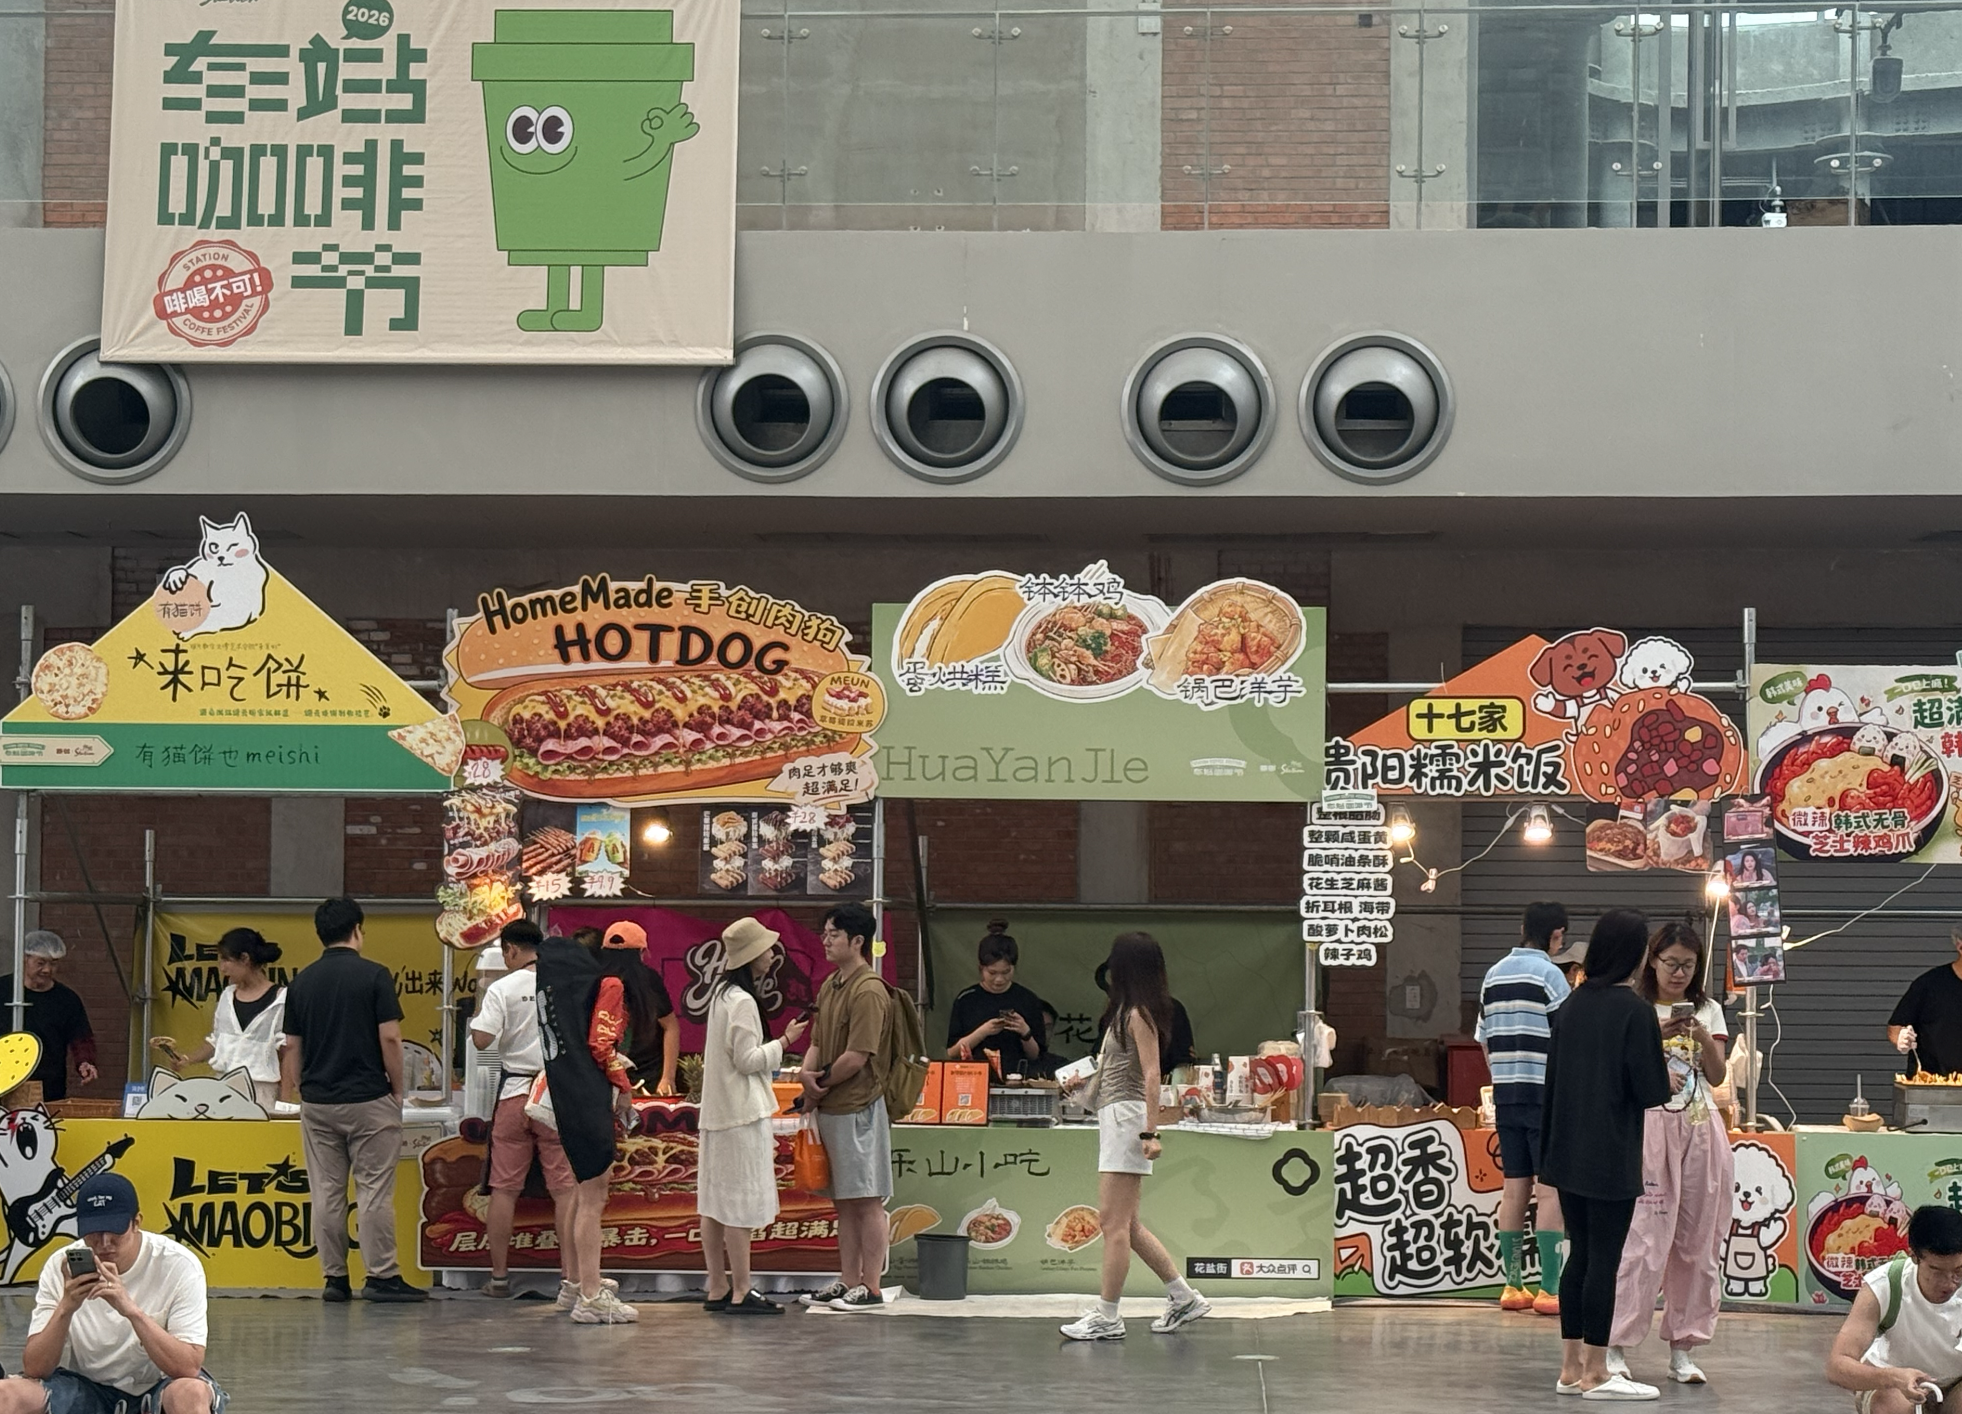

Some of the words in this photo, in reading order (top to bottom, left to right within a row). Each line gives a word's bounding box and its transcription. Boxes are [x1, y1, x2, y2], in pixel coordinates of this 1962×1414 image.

[346, 5, 391, 27] 2026
[162, 30, 427, 124] 车站
[157, 136, 425, 231] 咖啡
[182, 252, 229, 272] STATION
[163, 272, 262, 314] 啡喝不可!
[290, 243, 422, 336] 节
[182, 318, 214, 336] COFFE
[216, 302, 254, 335] FESTIVAL
[1019, 576, 1124, 605] 钵钵鸡
[480, 574, 674, 635] HomeMade
[685, 583, 844, 652] 手创肉狗
[554, 622, 789, 675] HOTDOG
[156, 643, 310, 702] 来吃饼
[830, 676, 870, 688] MEUN
[899, 661, 1008, 693] 蛋烘糕
[1177, 675, 1303, 706] 锅巴洋芋
[1765, 677, 1803, 699] 韩式美味
[1416, 702, 1508, 734] 十七家
[788, 761, 858, 780] 肉足才够爽
[1325, 740, 1568, 794] 贵阳糯米饭
[802, 778, 859, 797] 超满足!
[1791, 811, 1827, 828] 微辣
[1834, 810, 1908, 831] 韩式无骨
[1307, 829, 1388, 845] 整颗咸蛋黄
[1812, 833, 1914, 854] 芝士辣鸡爪
[1307, 853, 1389, 868] 脆哨油条酥
[1307, 876, 1388, 891] 花生芝麻酱
[1304, 900, 1353, 914] 折耳根
[1358, 900, 1391, 915] 海带
[1307, 923, 1389, 938] 酸萝卜肉松
[1324, 947, 1372, 962] 辣子鸡
[1335, 1134, 1452, 1220] 超香
[1194, 1262, 1228, 1274] 花盐街
[1255, 1263, 1298, 1275] 大众点评
